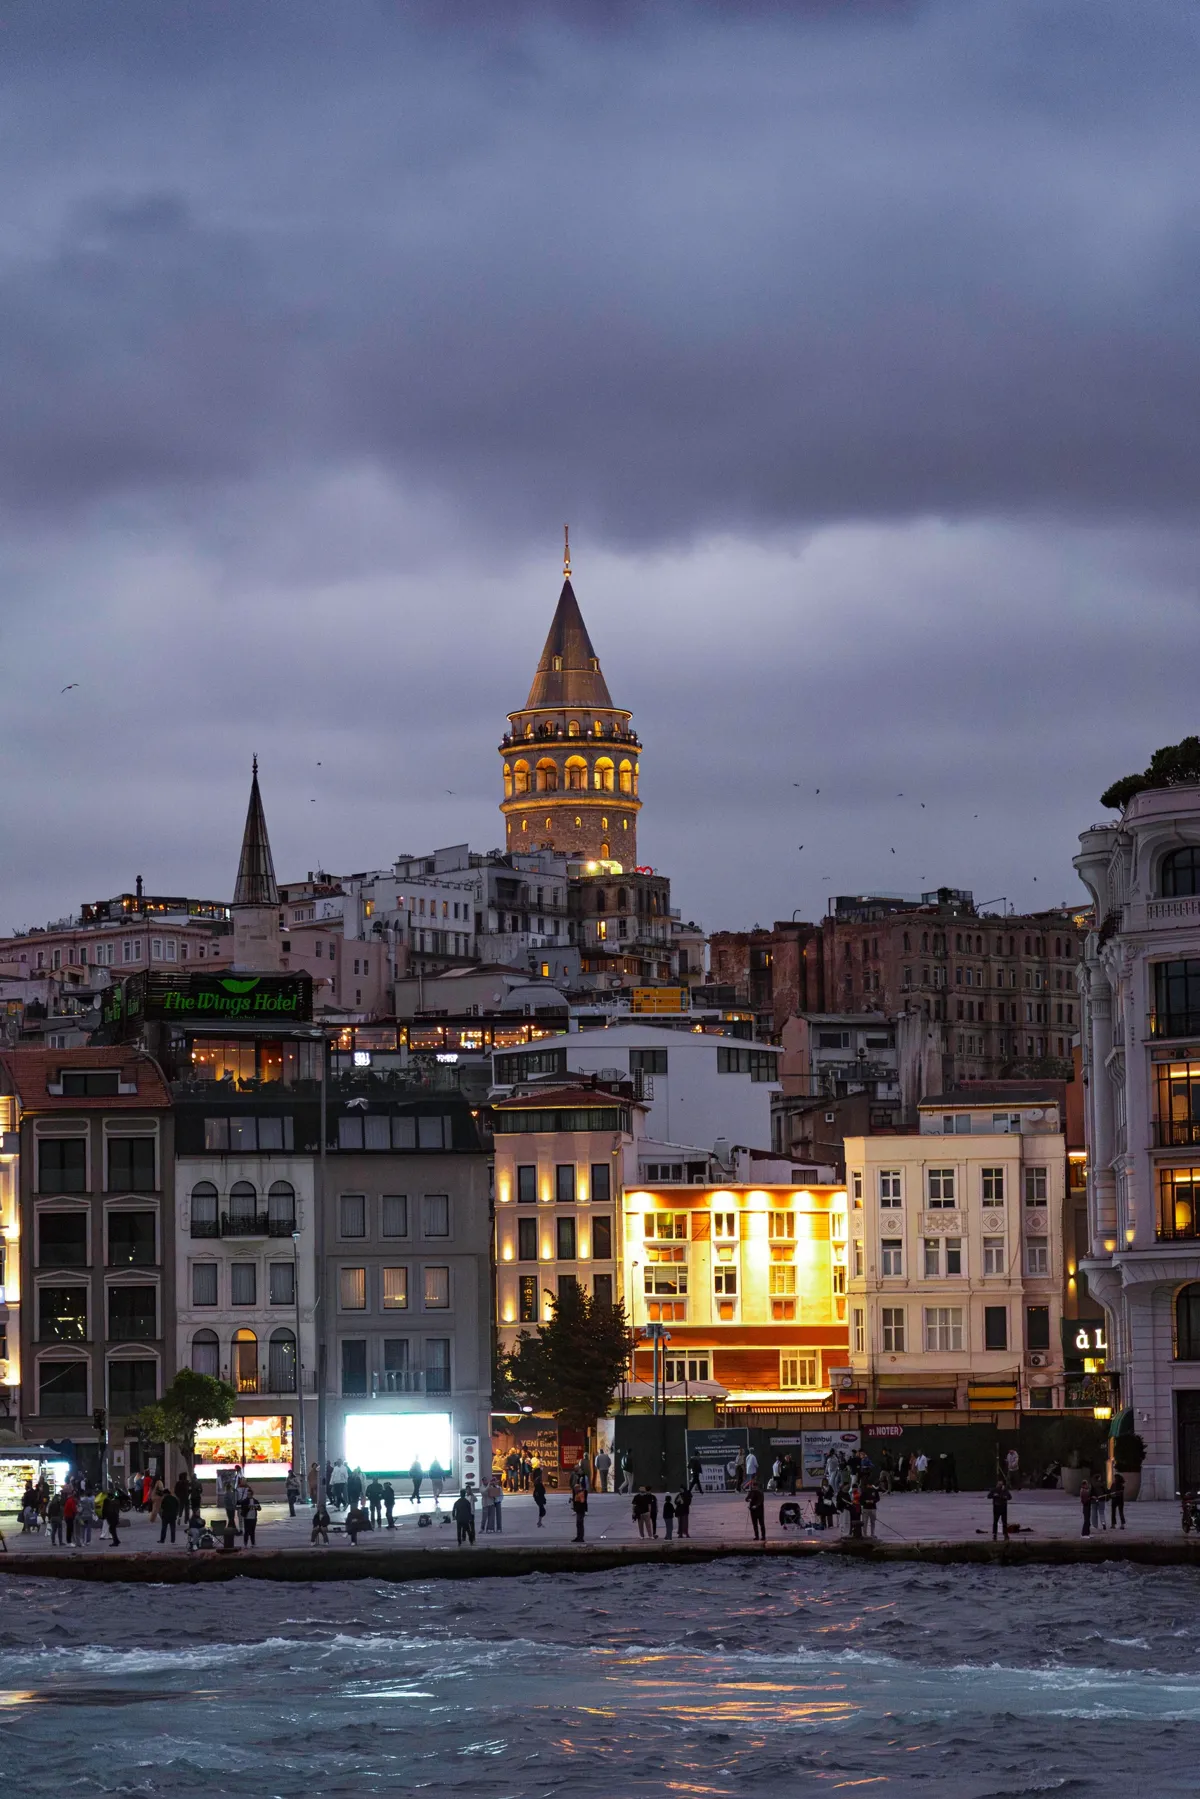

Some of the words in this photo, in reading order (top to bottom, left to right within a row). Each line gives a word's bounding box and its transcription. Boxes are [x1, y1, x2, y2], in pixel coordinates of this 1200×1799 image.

[164, 992, 195, 1010] The
[197, 992, 250, 1014] Wings
[253, 993, 297, 1011] Hotel
[1075, 1328, 1090, 1349] à
[876, 1426, 899, 1436] NOTER
